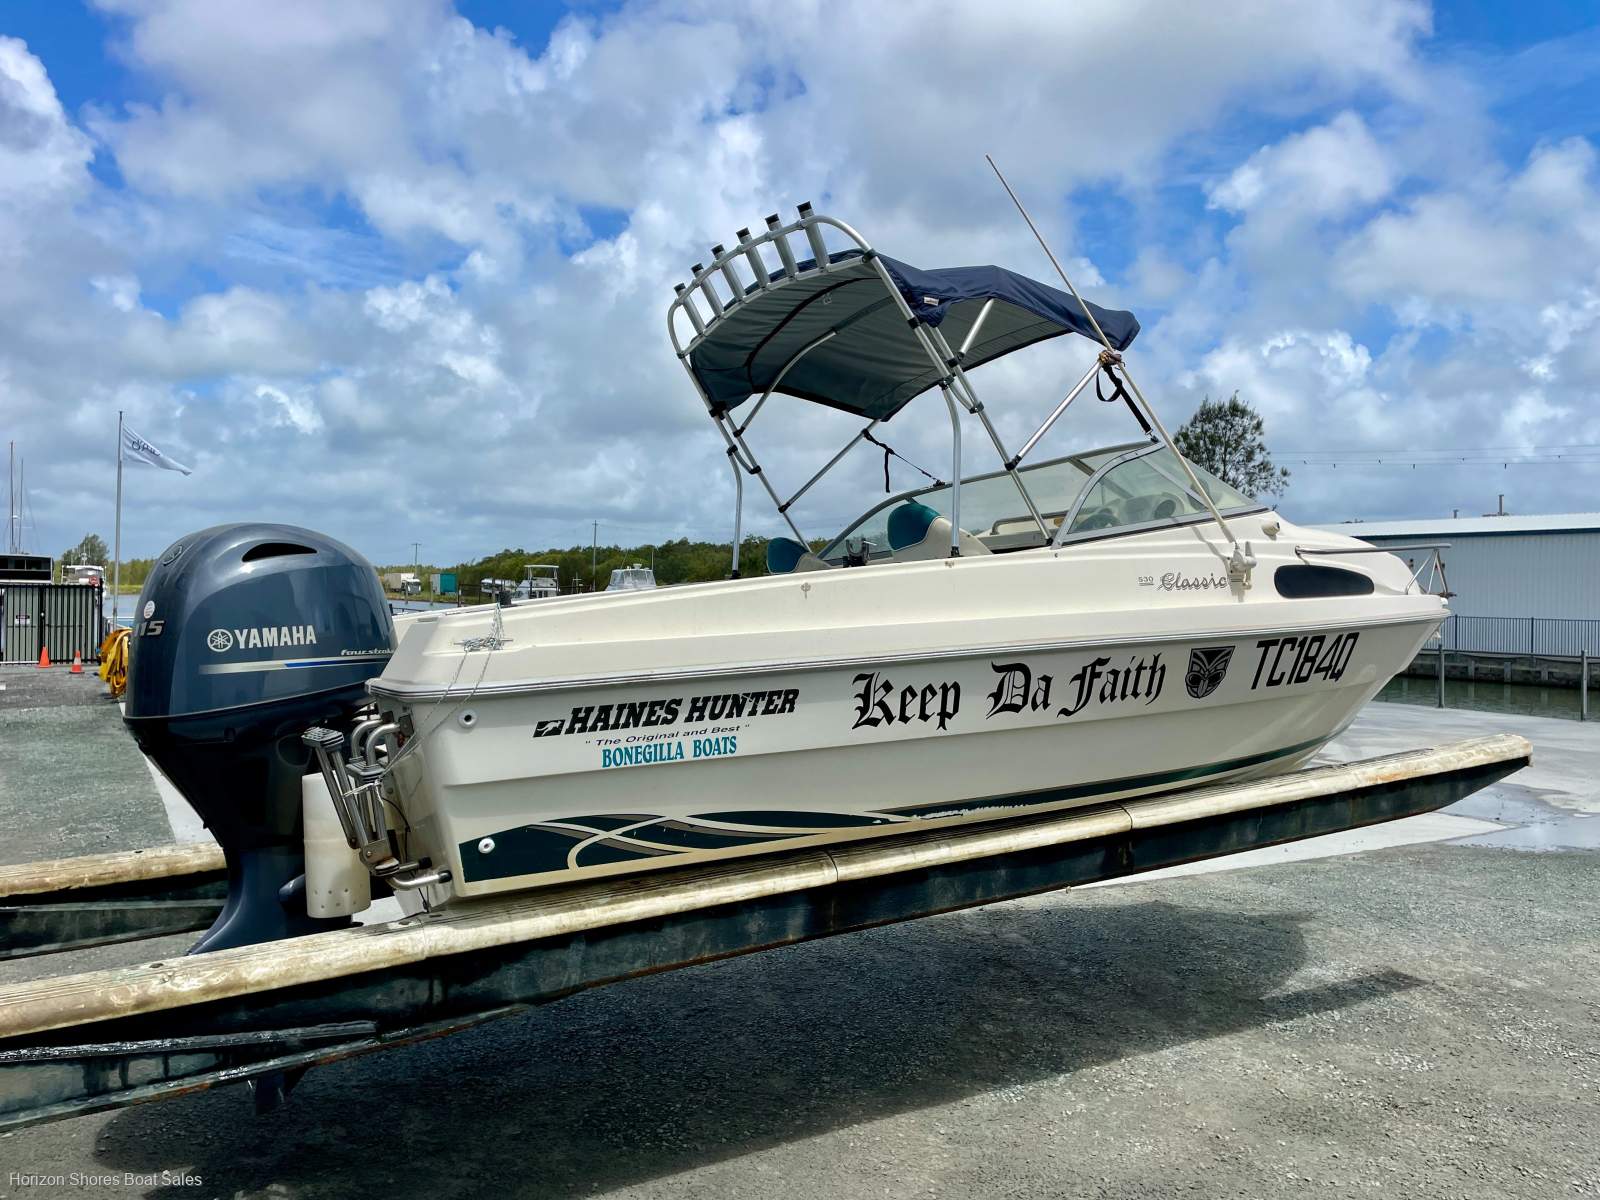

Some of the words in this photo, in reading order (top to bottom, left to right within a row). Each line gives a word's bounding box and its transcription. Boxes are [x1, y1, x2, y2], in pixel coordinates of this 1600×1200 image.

[1138, 576, 1154, 584] 530
[1157, 572, 1228, 592] Classic
[234, 625, 317, 649] YAMAHA
[1251, 632, 1360, 690] TC184Q
[851, 671, 962, 731] Keep
[986, 661, 1055, 720] Da
[1057, 652, 1167, 718] Faith
[565, 697, 682, 735] HAINES
[684, 688, 800, 723] HUNTER
[596, 737, 622, 746] The
[625, 730, 680, 744] Original
[682, 728, 708, 738] and
[711, 724, 742, 734] Best
[601, 745, 685, 768] BONEGILLA
[692, 736, 738, 759] BOATS
